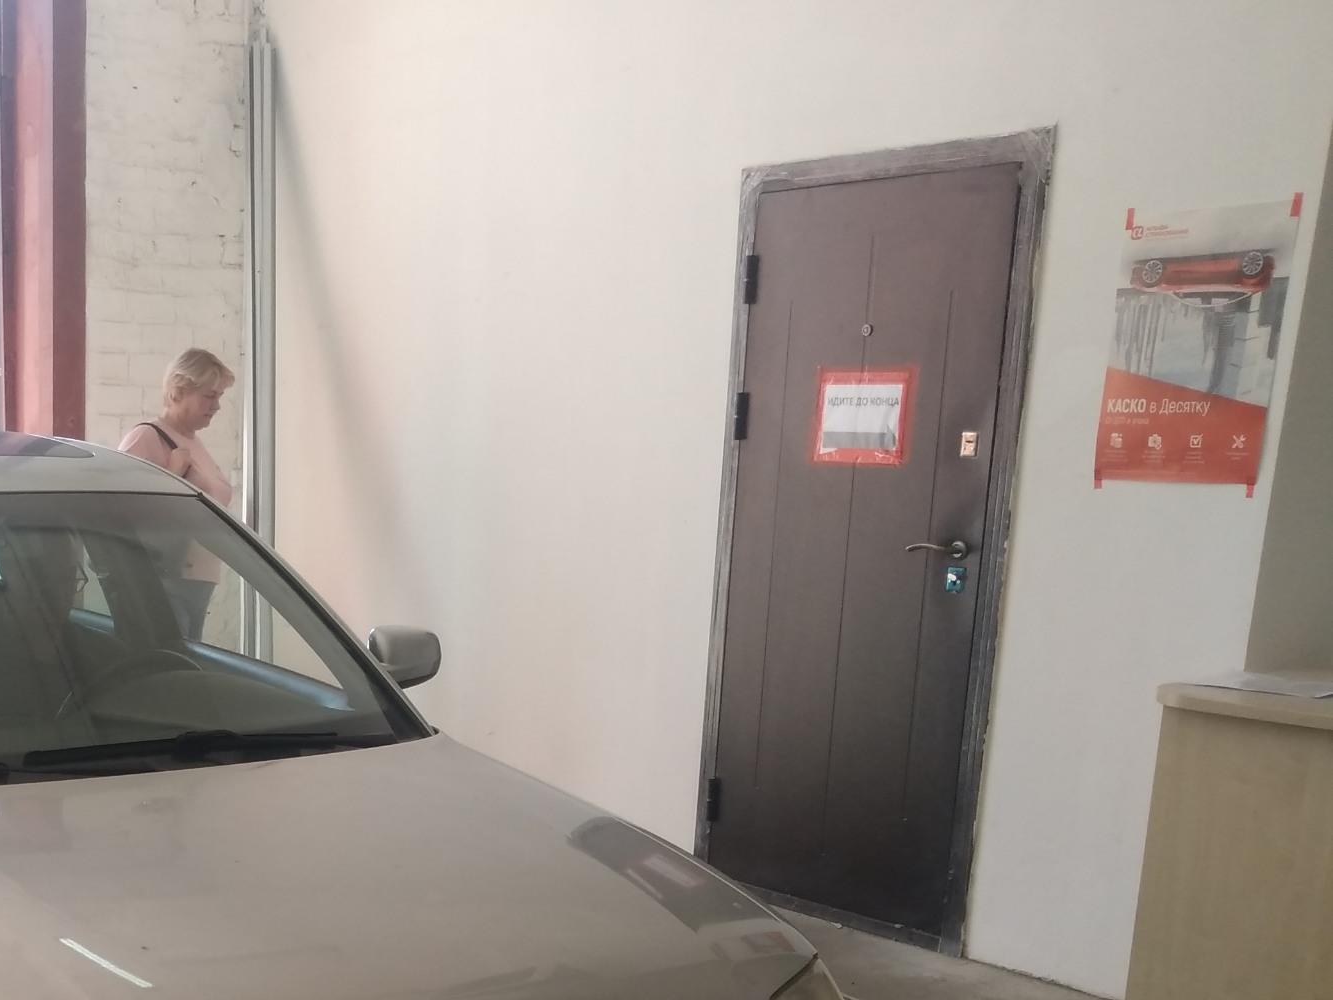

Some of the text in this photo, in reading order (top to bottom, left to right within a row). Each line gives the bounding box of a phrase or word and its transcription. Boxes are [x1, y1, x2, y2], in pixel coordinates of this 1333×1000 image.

[855, 396, 869, 408] ДО
[1106, 398, 1211, 417] КАСКО в Десятку
